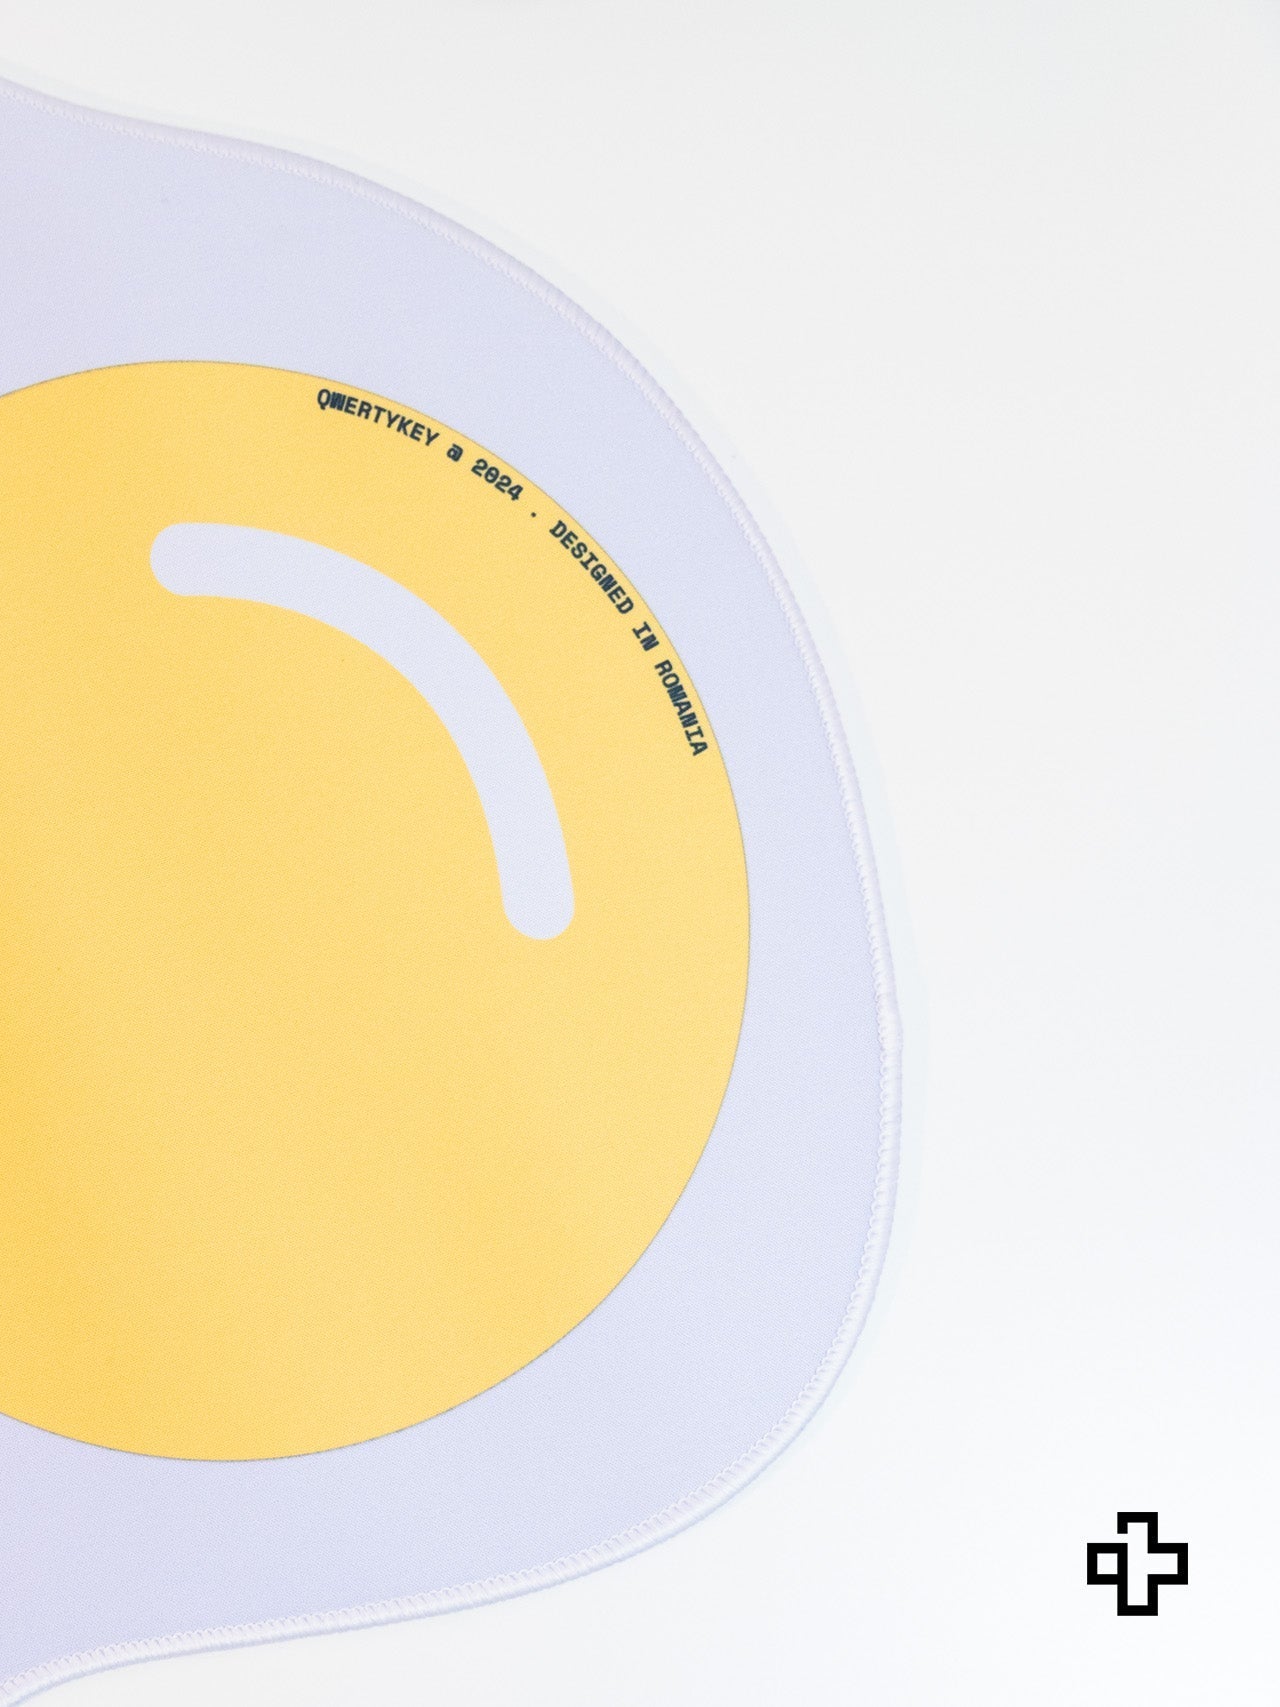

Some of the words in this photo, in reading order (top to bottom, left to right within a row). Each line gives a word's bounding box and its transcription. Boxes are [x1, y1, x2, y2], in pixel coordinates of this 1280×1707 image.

[316, 388, 441, 447] QWERTYKEY
[470, 458, 524, 501] 2024
[548, 519, 634, 615] DESIGNED
[631, 621, 660, 652] IN
[654, 659, 709, 757] ROMANIA
